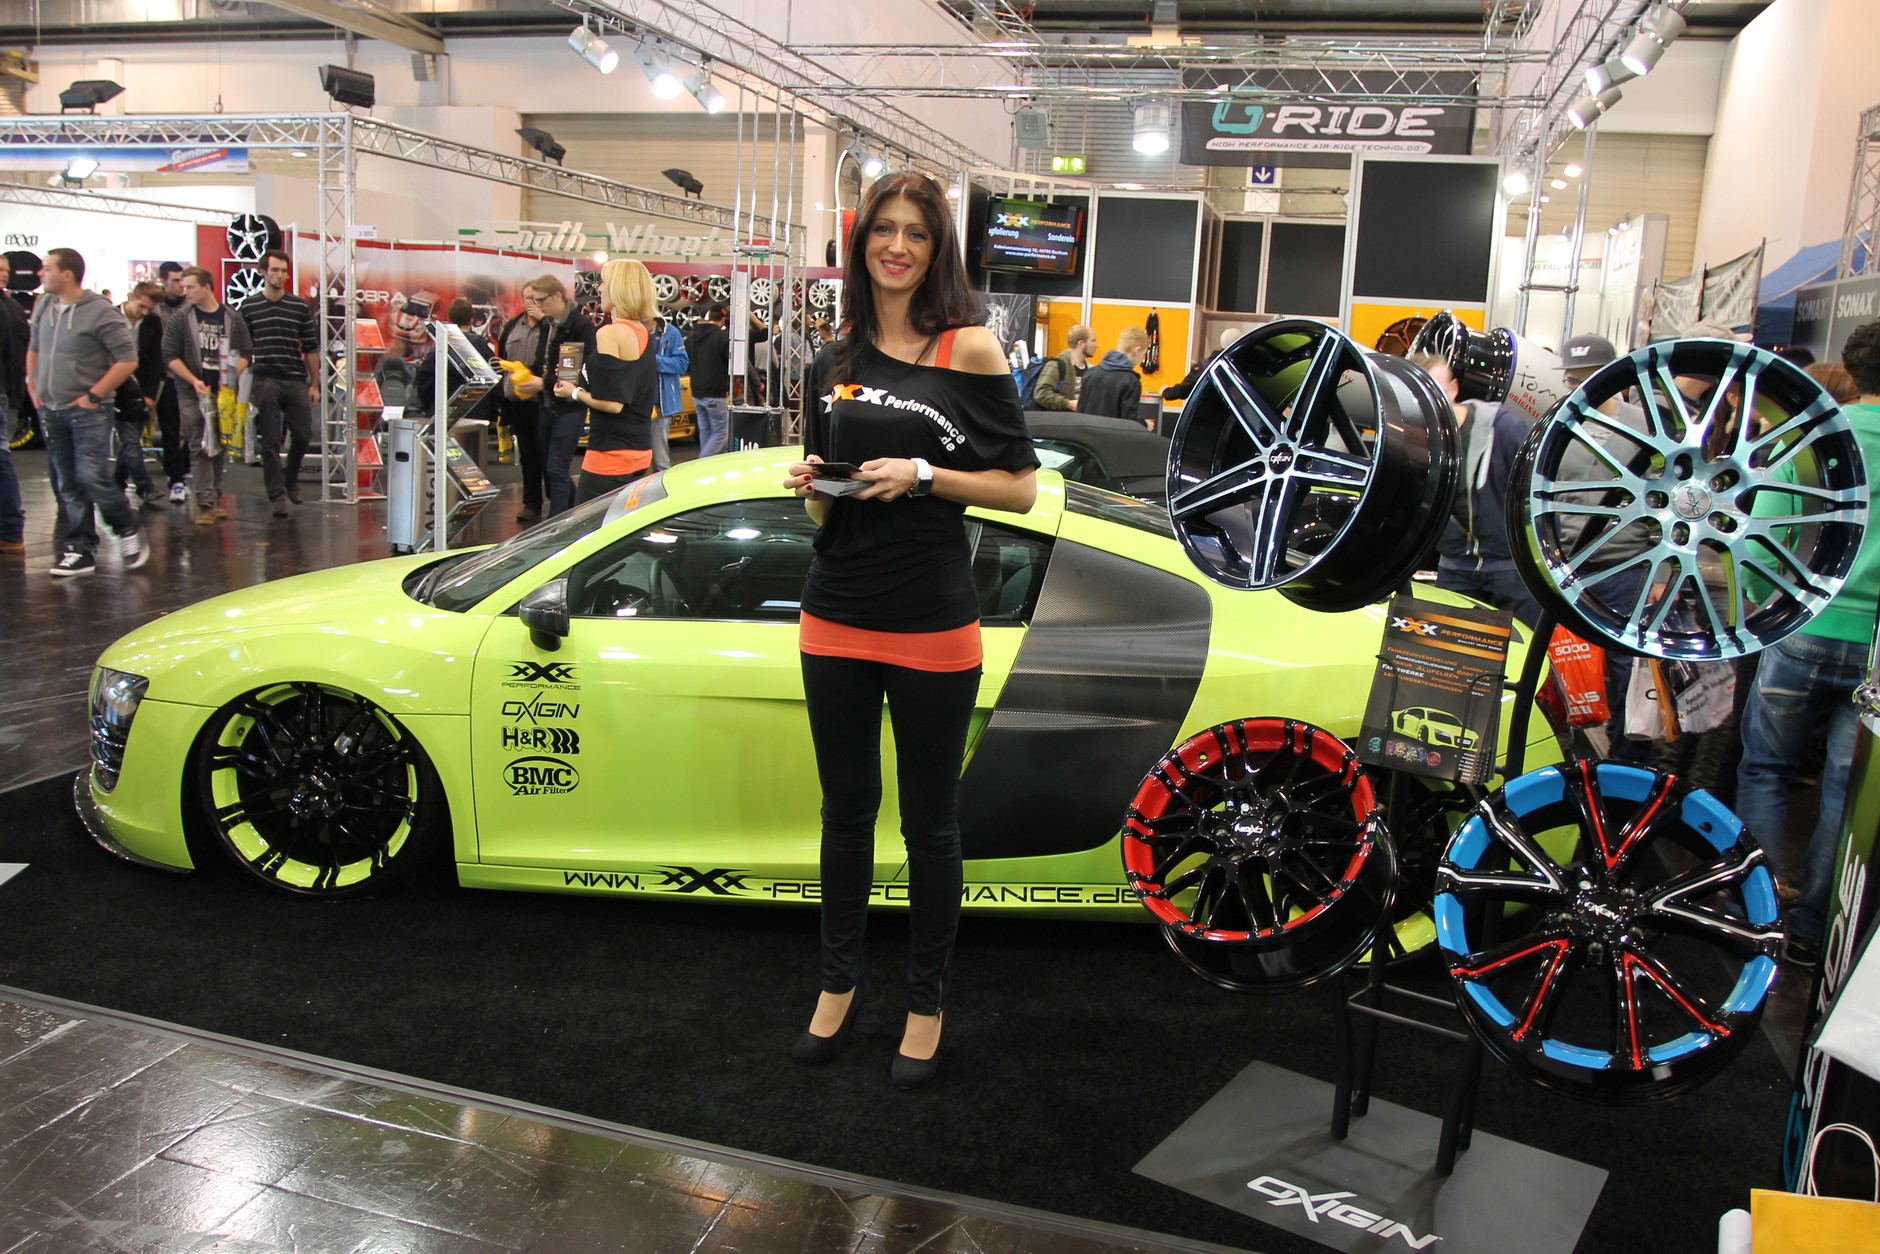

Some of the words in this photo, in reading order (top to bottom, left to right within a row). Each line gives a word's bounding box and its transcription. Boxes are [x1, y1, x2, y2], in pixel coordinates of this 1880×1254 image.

[1212, 86, 1445, 136] G-RIDE
[1361, 144, 1427, 152] TECHNOLOGY
[1030, 219, 1072, 229] PERFORMANCE
[1047, 232, 1075, 243] Sonderein
[1796, 299, 1828, 322] SONAX
[1836, 290, 1874, 318] SONAX
[1522, 392, 1538, 405] DAS
[884, 395, 967, 445] Performance
[1440, 629, 1505, 647] PERFORMANCE
[1555, 642, 1590, 656] 5000
[1382, 663, 1425, 679] FAHWERKE
[1416, 666, 1459, 680] ALUFELGEN
[501, 682, 582, 691] PERFORMANCE
[1383, 672, 1463, 694] LEITUNGSSTEIGERUNGEN
[502, 691, 581, 726] OXIGIN
[502, 726, 551, 753] H&R
[511, 766, 573, 787] BMC
[512, 785, 541, 796] Air
[542, 786, 568, 795] Filter
[1842, 875, 1864, 972] ECHNOLOGY
[1246, 1175, 1444, 1250] OXIGIN
